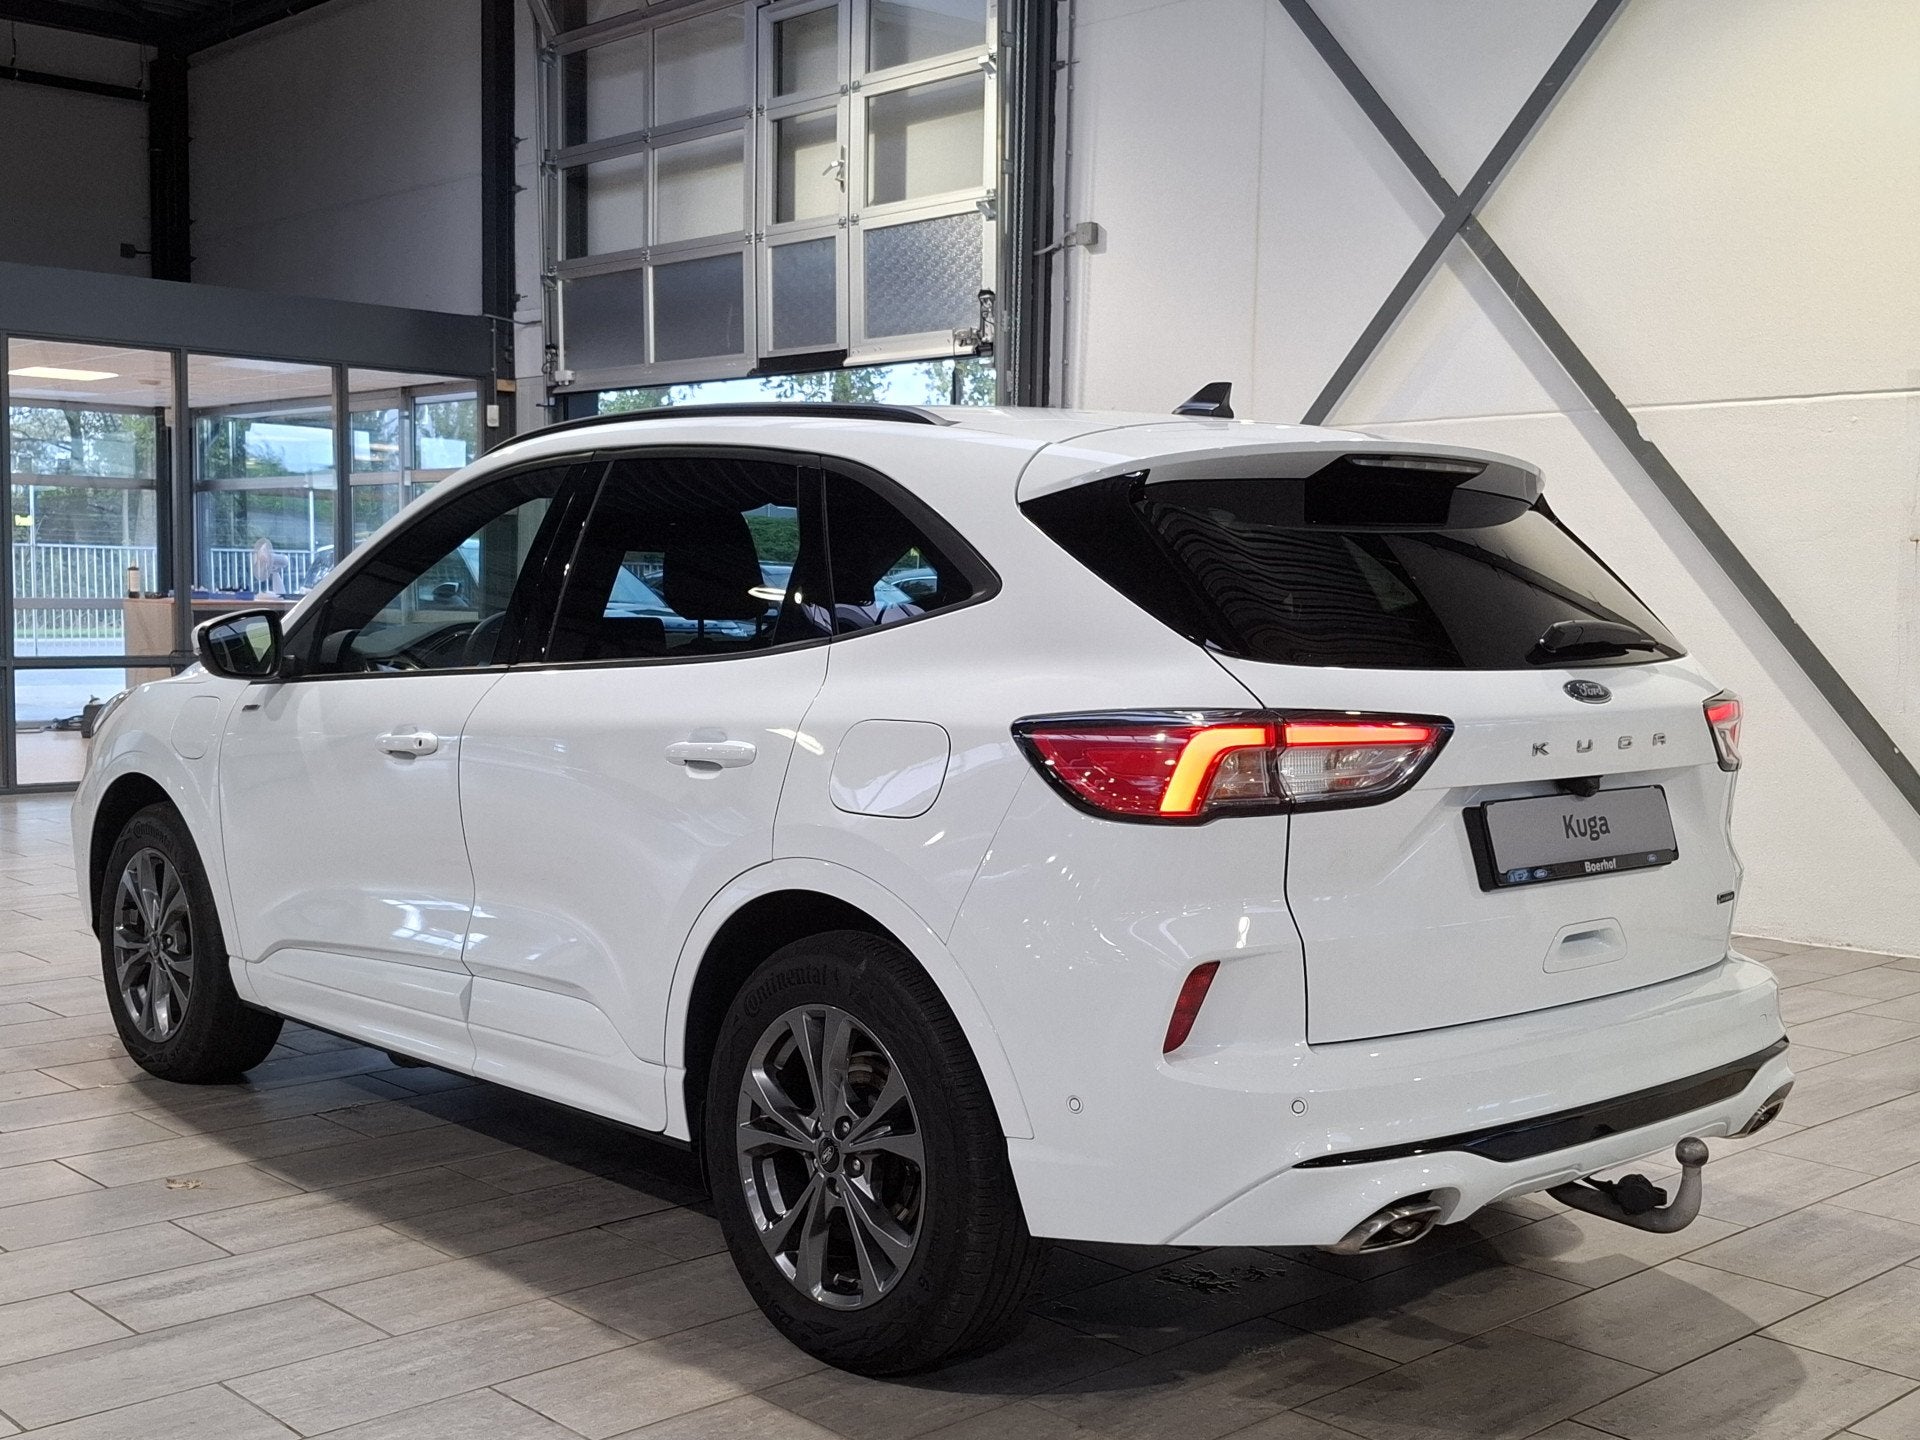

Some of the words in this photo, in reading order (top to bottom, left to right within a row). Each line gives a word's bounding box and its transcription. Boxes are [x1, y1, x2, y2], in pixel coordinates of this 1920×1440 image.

[1531, 733, 1666, 757] KUGA
[1562, 814, 1610, 841] Kuga
[1584, 857, 1617, 873] Boerhof
[744, 963, 828, 1018] Continental
